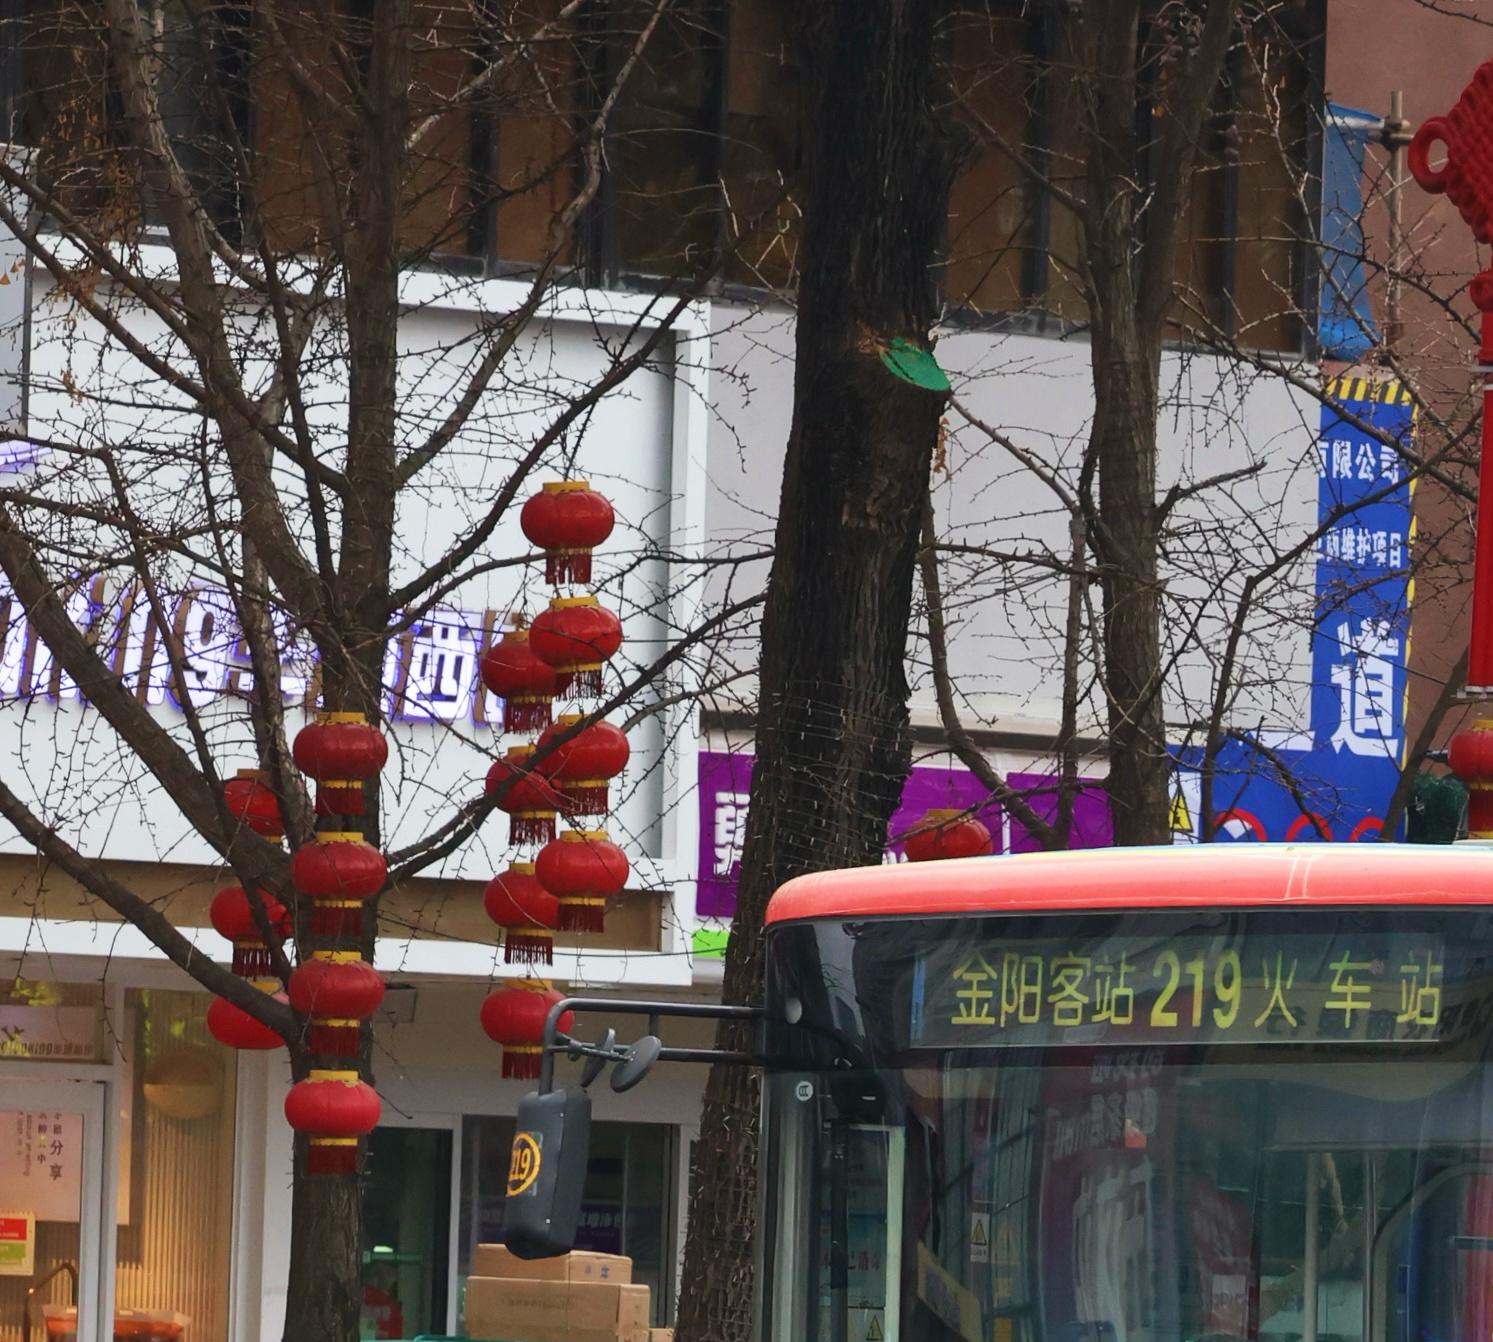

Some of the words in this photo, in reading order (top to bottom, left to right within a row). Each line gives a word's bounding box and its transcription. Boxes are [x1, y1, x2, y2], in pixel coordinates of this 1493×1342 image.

[1316, 527, 1401, 568] 维护项目
[1330, 617, 1399, 758] 道
[950, 951, 1134, 1028] 金阳客站
[1150, 949, 1243, 1030] 219
[1254, 949, 1440, 1030] 火车站
